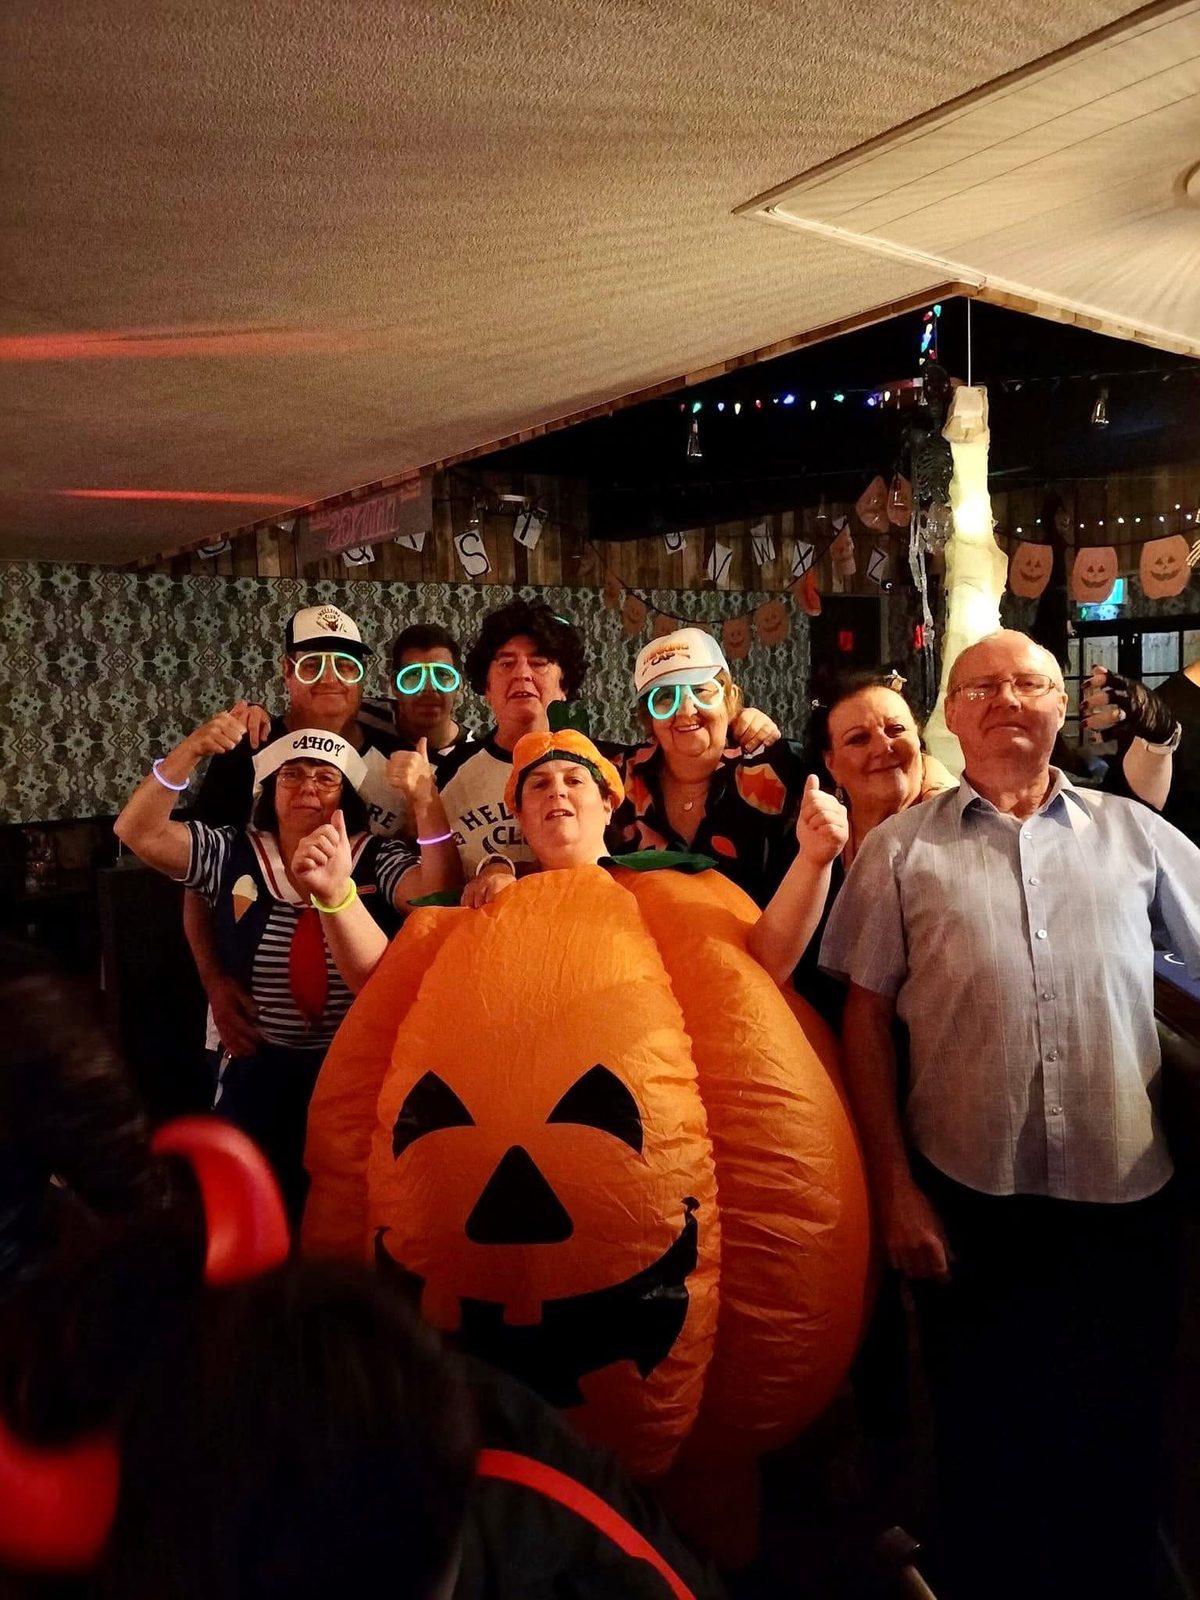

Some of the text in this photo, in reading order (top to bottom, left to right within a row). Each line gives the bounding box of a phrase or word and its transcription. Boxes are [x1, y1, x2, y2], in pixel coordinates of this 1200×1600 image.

[459, 533, 489, 577] S
[792, 541, 814, 573] X
[292, 735, 346, 758] AHOY
[368, 802, 398, 830] RE
[459, 802, 515, 832] HEL
[492, 825, 529, 846] CL
